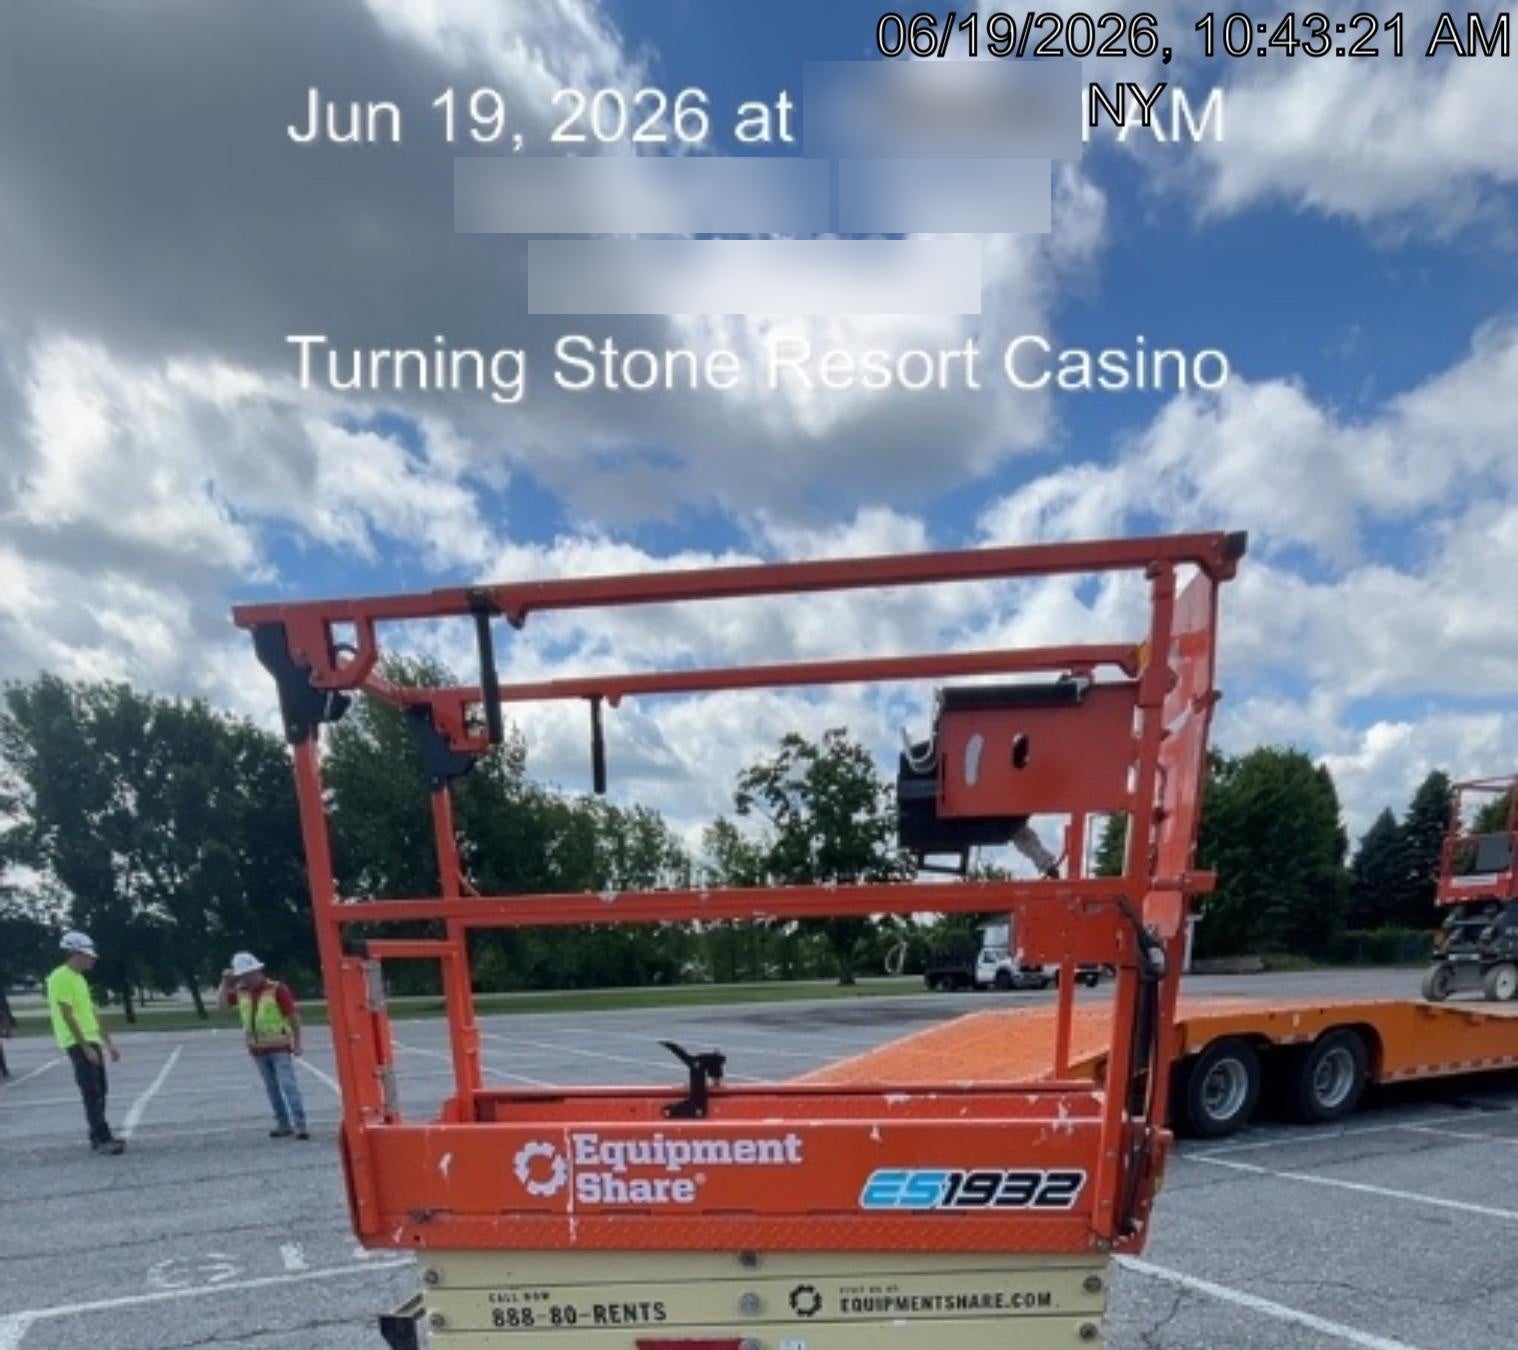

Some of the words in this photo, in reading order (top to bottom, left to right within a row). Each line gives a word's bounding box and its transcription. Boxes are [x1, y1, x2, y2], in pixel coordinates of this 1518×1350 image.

[572, 1132, 803, 1172] Equipment
[858, 1167, 1088, 1210] ES1932
[491, 1301, 668, 1328] 888-80-RENTS
[839, 1291, 1052, 1313] EQUIPMENTSHARE.COM
